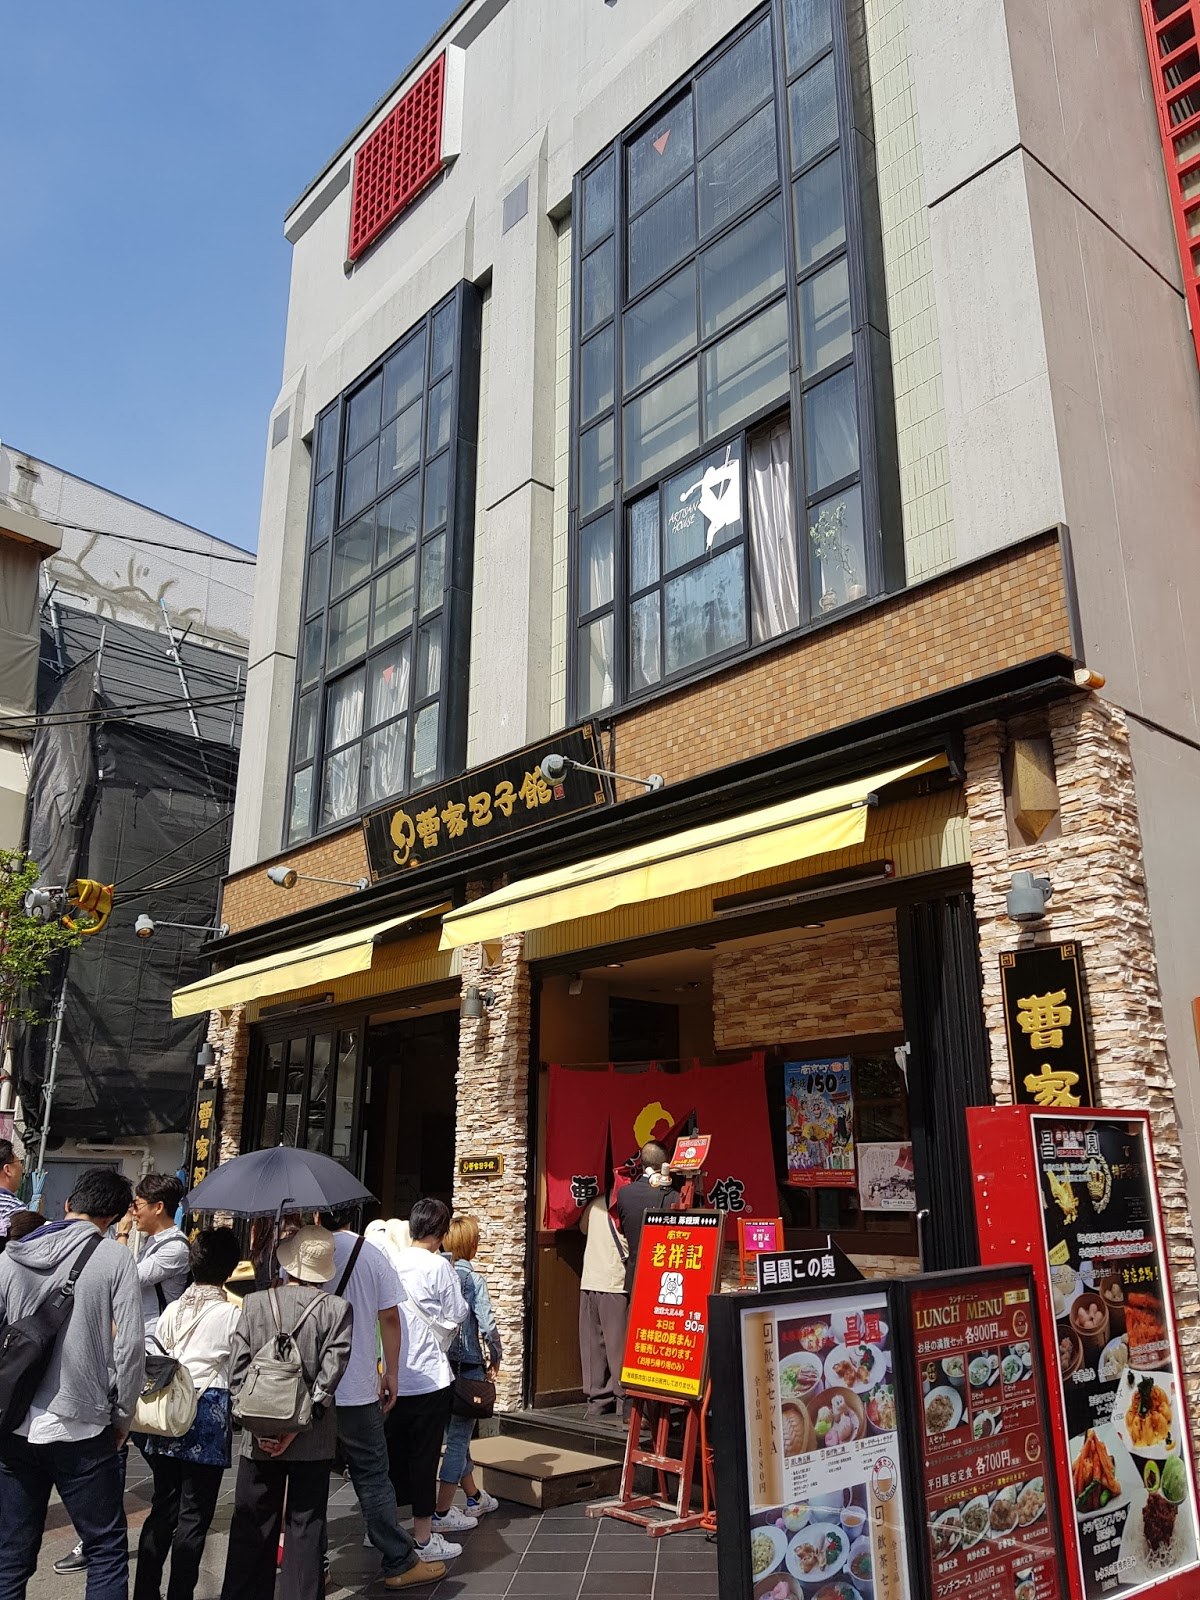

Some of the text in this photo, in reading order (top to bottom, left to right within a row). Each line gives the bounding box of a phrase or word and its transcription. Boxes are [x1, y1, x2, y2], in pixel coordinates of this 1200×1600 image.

[668, 501, 700, 525] ARTISAN
[672, 513, 695, 534] HOUSE
[651, 1243, 703, 1269] 老祥記
[763, 1255, 836, 1285] 昌園この奥
[656, 1319, 675, 1330] 本日は
[684, 1319, 704, 1333] 90円
[916, 1298, 1003, 1330] LUNCH MENU
[965, 1322, 999, 1345] 各900円
[976, 1450, 1011, 1476] 各700円
[937, 1574, 973, 1598] ランチコース
